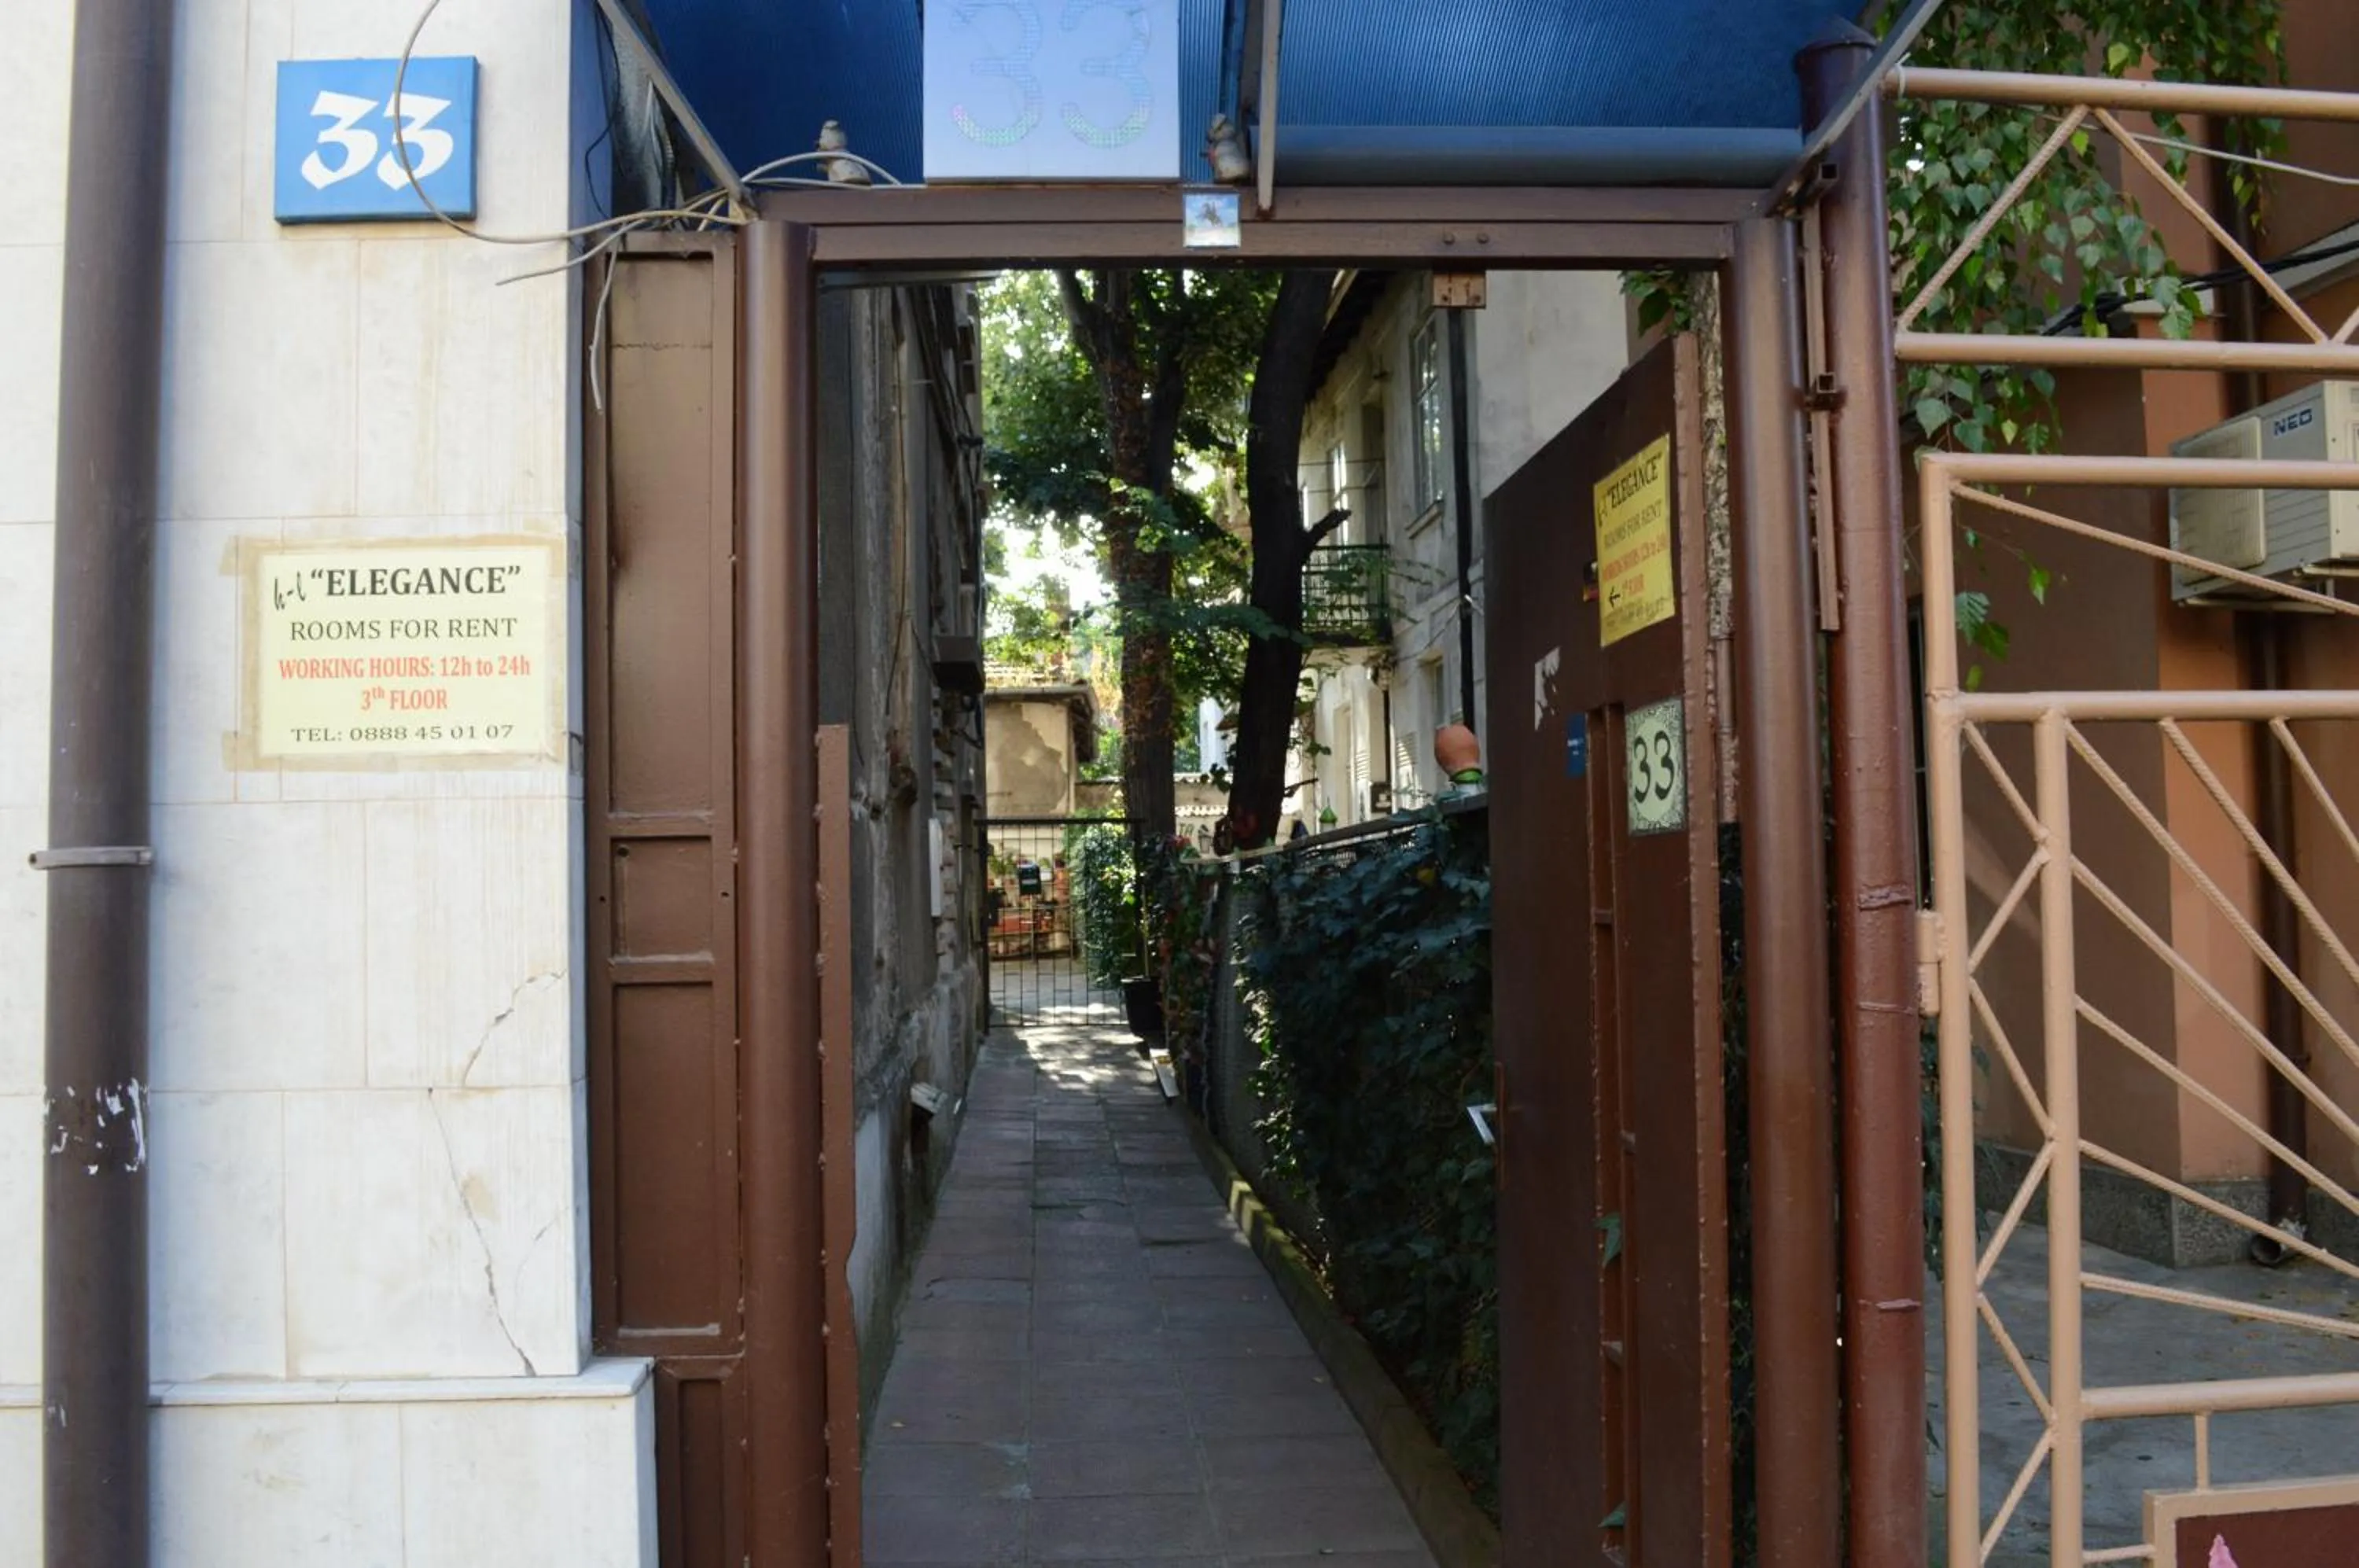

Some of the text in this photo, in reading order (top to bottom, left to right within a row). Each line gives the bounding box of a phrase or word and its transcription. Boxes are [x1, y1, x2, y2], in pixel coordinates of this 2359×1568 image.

[950, 0, 1153, 148] 33
[301, 90, 454, 191] 33
[2273, 408, 2313, 436] NEO
[311, 565, 521, 596] “ELEGANCE”
[291, 617, 517, 641] ROOMS FOR RENT
[279, 654, 531, 680] WORKING HOURS: 12h to 24h
[361, 686, 447, 711] 3th FLOOR
[290, 723, 514, 742] TEL: 0888 45 01 07
[1633, 730, 1675, 803] 33
